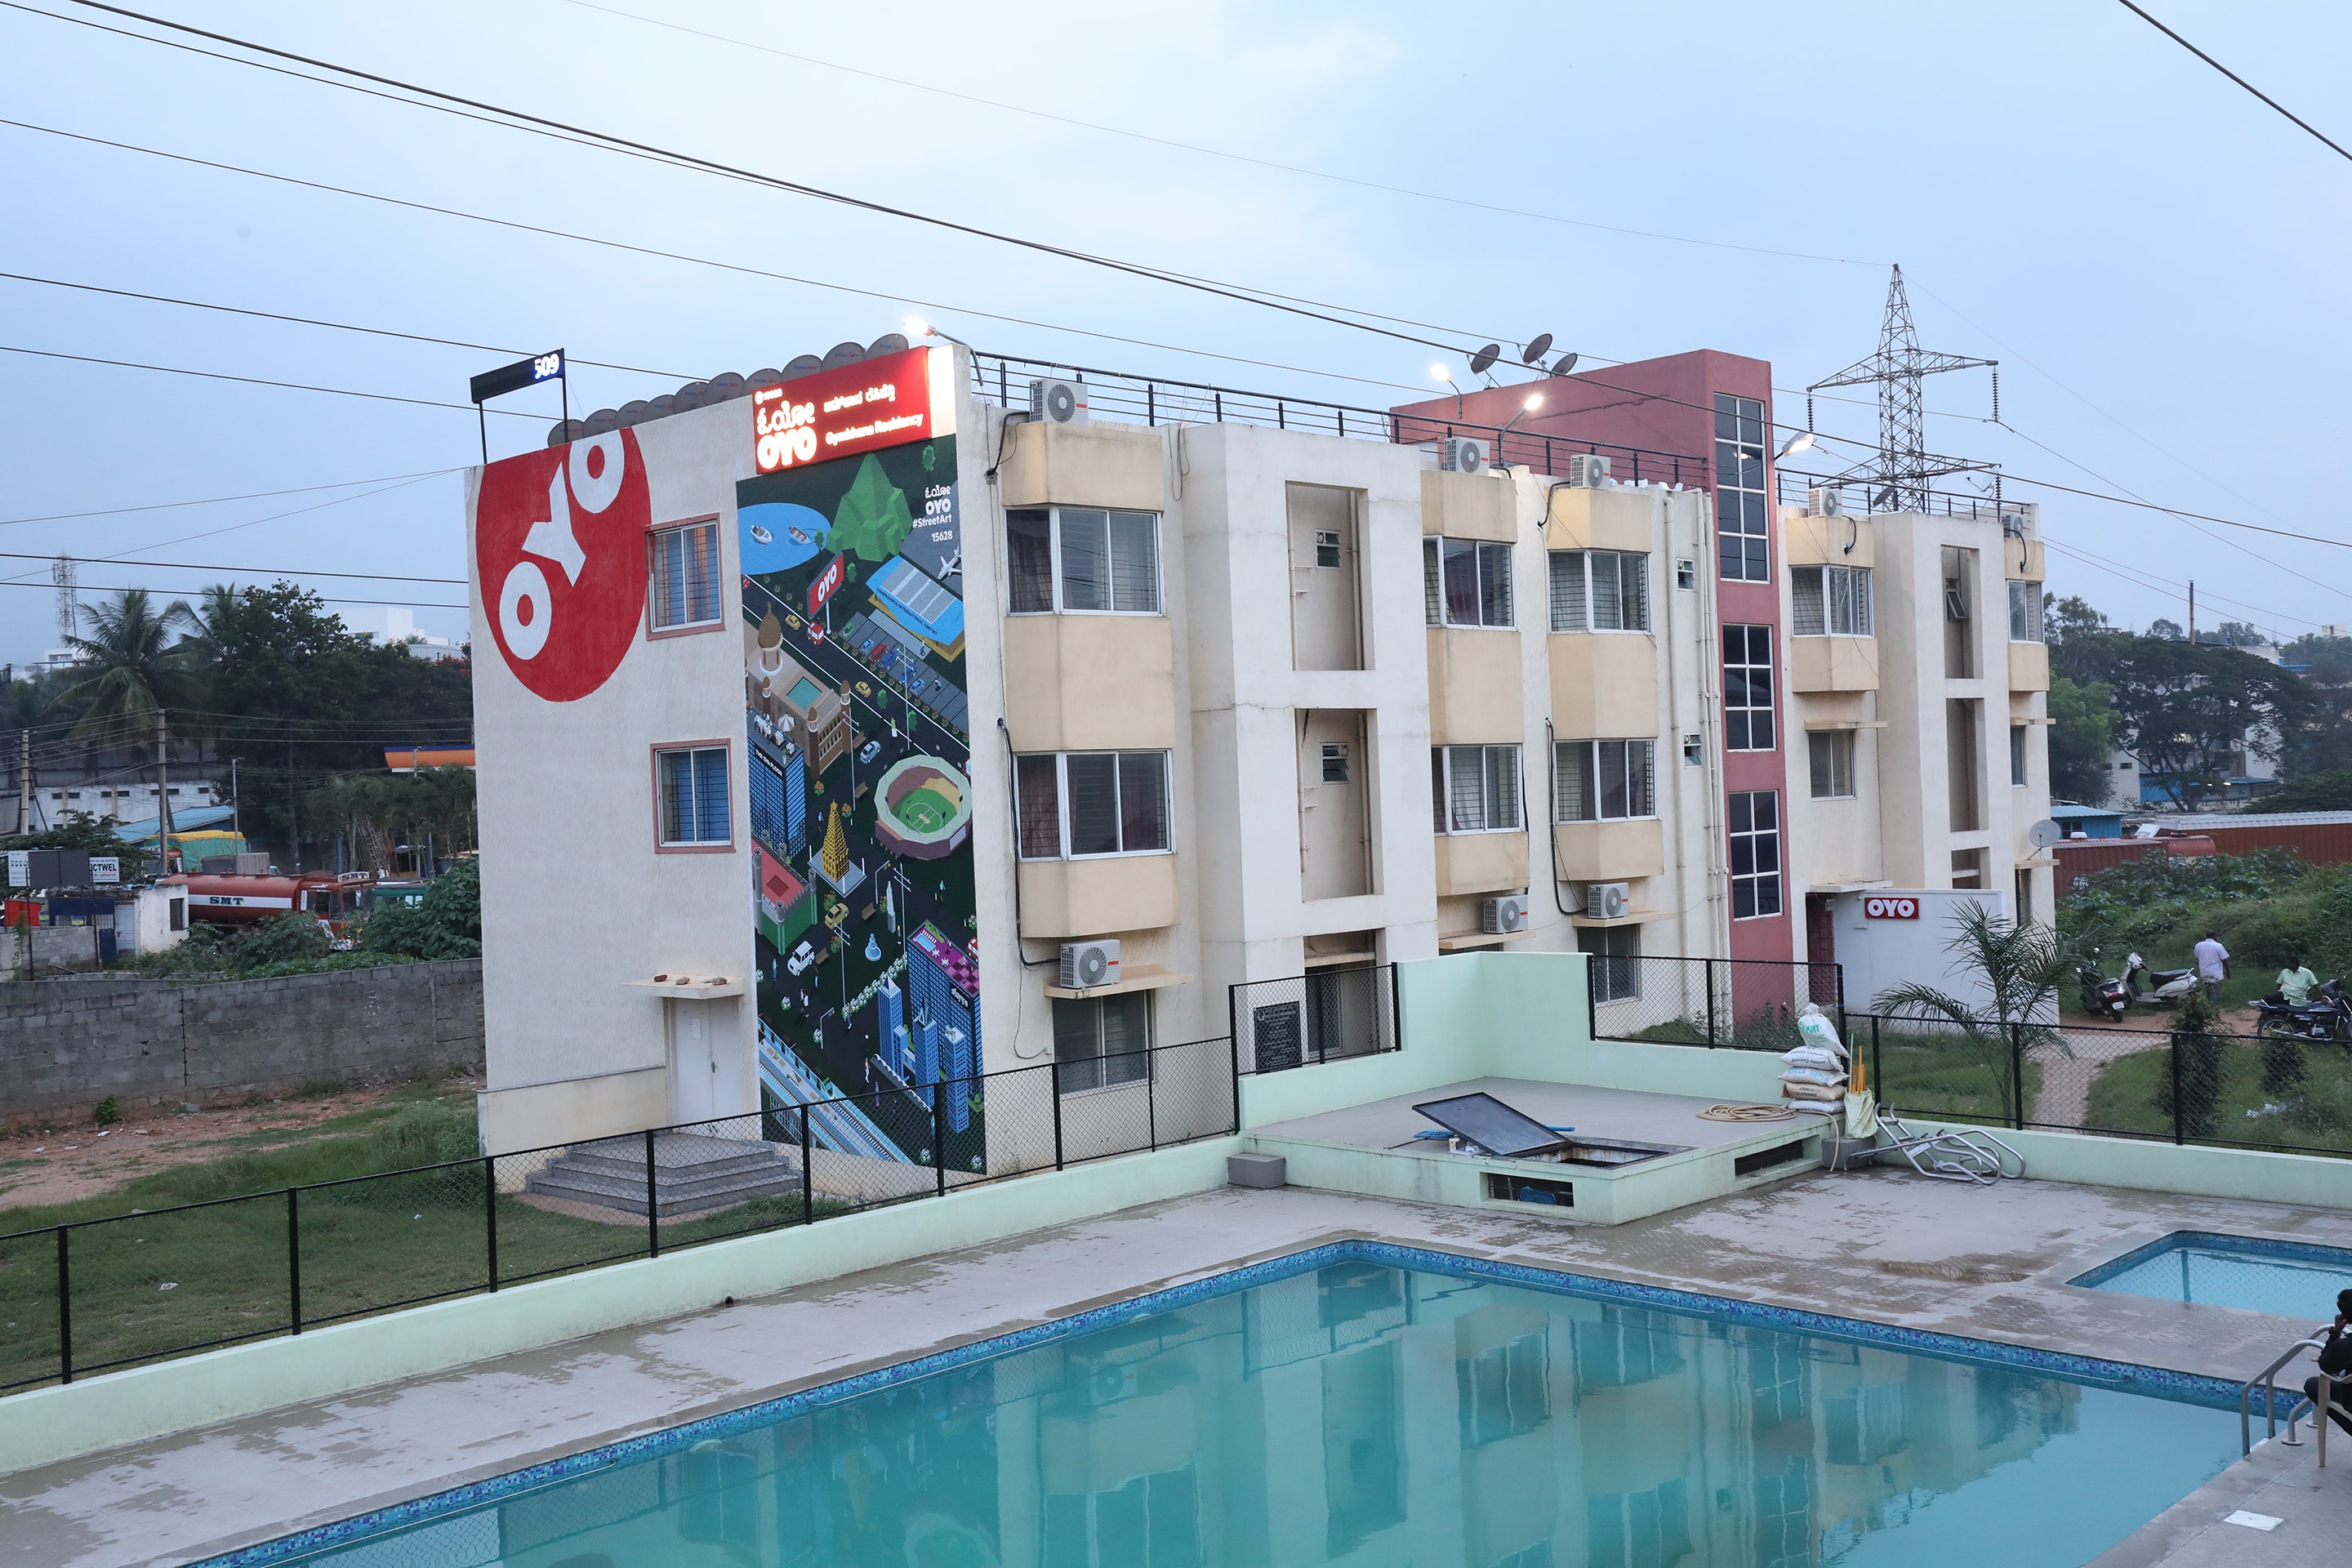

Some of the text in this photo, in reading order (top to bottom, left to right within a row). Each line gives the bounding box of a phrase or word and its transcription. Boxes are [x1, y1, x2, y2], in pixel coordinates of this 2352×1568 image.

[534, 353, 560, 380] 509
[825, 413, 924, 446] Gymkhana Residency
[757, 425, 817, 470] OYO
[925, 497, 951, 515] OYO
[912, 513, 952, 529] #StreetArt
[931, 530, 953, 542] 15628
[817, 564, 837, 602] OYO
[209, 896, 244, 906] SMT
[1867, 899, 1915, 917] OYO
